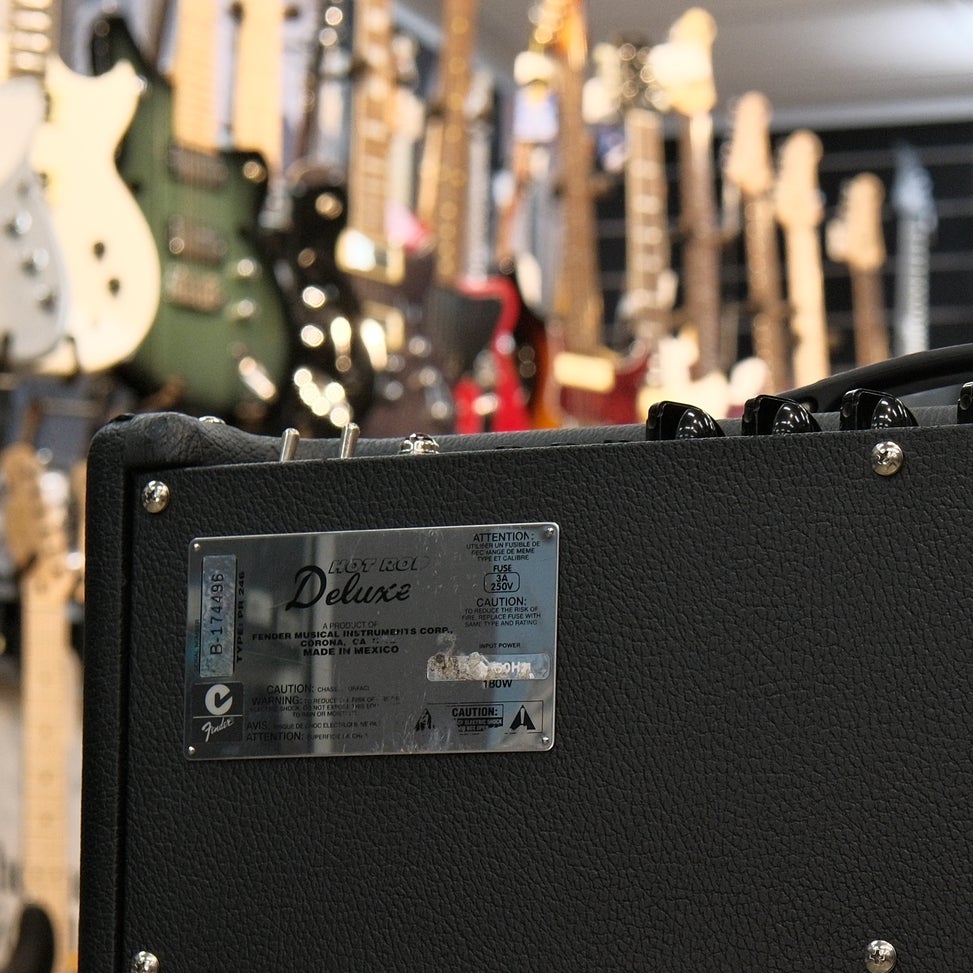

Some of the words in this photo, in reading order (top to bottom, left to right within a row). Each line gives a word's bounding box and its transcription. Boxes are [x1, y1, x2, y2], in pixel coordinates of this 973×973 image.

[473, 531, 534, 542] ATTENTION:
[493, 564, 512, 572] FUSE
[496, 574, 508, 582] 3A
[284, 565, 411, 611] Deluxe
[491, 582, 513, 591] 250V
[476, 597, 527, 607] CAUTION:
[210, 573, 224, 655] B-174496
[329, 621, 366, 629] PRODUCT
[368, 620, 378, 628] OF
[252, 632, 291, 640] FENDER
[294, 630, 340, 639] MUSICAL
[343, 628, 417, 637] INSTRUMENTS
[300, 639, 345, 647] CORONA,
[303, 648, 335, 656] MADE
[339, 647, 350, 655] IN
[354, 645, 399, 655] MEXICO
[483, 679, 513, 688] 180W
[266, 684, 314, 694] CAUTION:
[252, 695, 303, 705] WARNING:
[452, 707, 498, 717] CAUTION:
[246, 731, 304, 741] ATTENTION:
